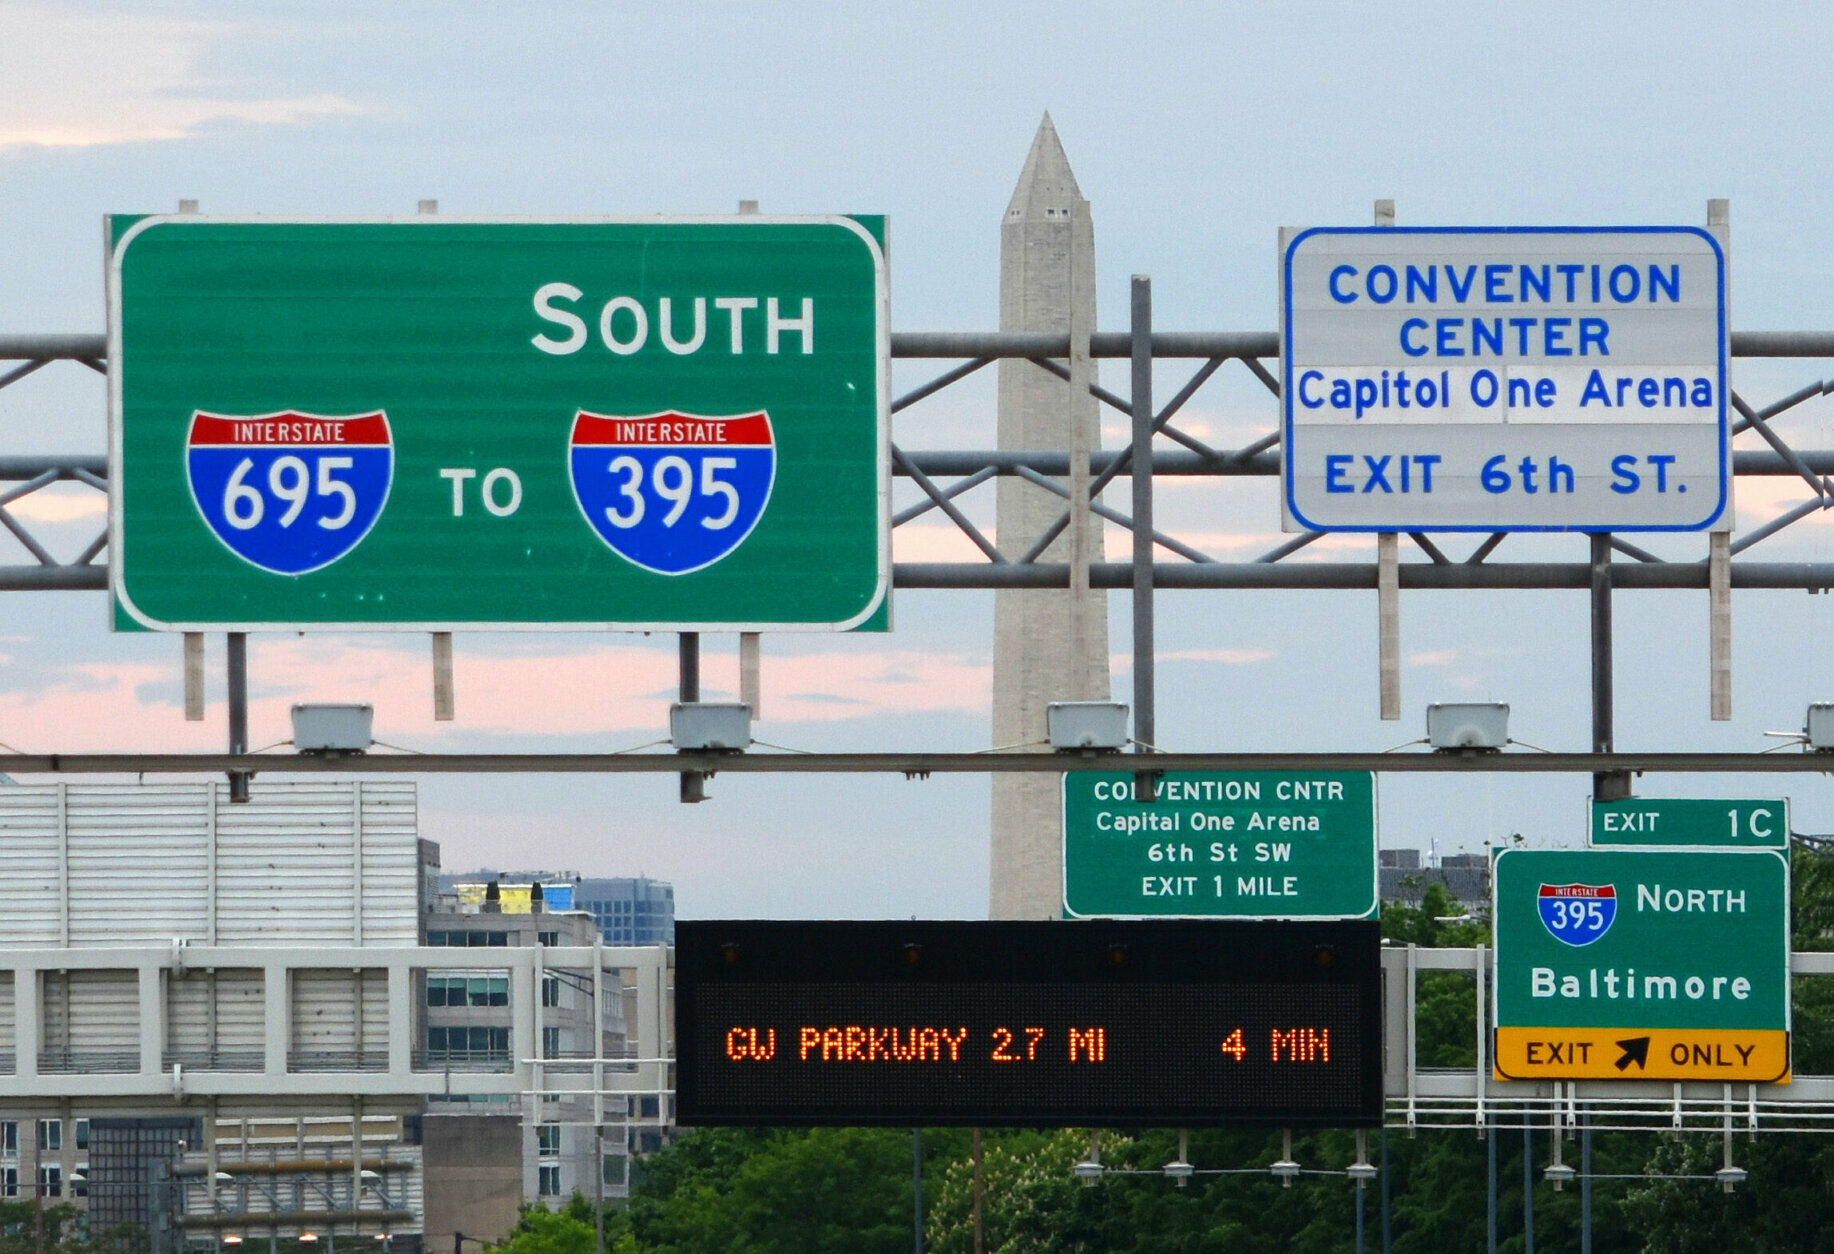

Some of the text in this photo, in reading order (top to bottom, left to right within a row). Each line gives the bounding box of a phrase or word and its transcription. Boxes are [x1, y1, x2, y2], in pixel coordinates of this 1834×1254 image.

[1329, 264, 1680, 304] CONVENTION
[530, 282, 814, 355] SOUTH
[1400, 318, 1610, 357] CENTER
[1299, 369, 1713, 420] Capitol One Arena
[233, 422, 345, 442] INTERSTATE
[615, 422, 727, 442] INTERSTATE
[1326, 455, 1687, 494] EXIT 6th ST.
[222, 456, 357, 530] 695
[440, 467, 523, 517] TO
[605, 456, 740, 530] 395
[1094, 781, 1344, 800] COVENTION CNTR
[1097, 812, 1320, 836] Capital One Arena
[1604, 813, 1659, 831] EXIT
[1148, 843, 1291, 862] 6th St SW
[1142, 876, 1298, 897] EXIT 1 MILE
[1555, 888, 1599, 897] INTERSTATE
[1637, 884, 1745, 912] NORTH
[1552, 901, 1603, 930] 395
[1532, 967, 1751, 999] Baltimore
[727, 1027, 1328, 1062] GW PARKWAY 2.7 MI 4 MIN
[1527, 1042, 1755, 1066] EXIT ONLY
